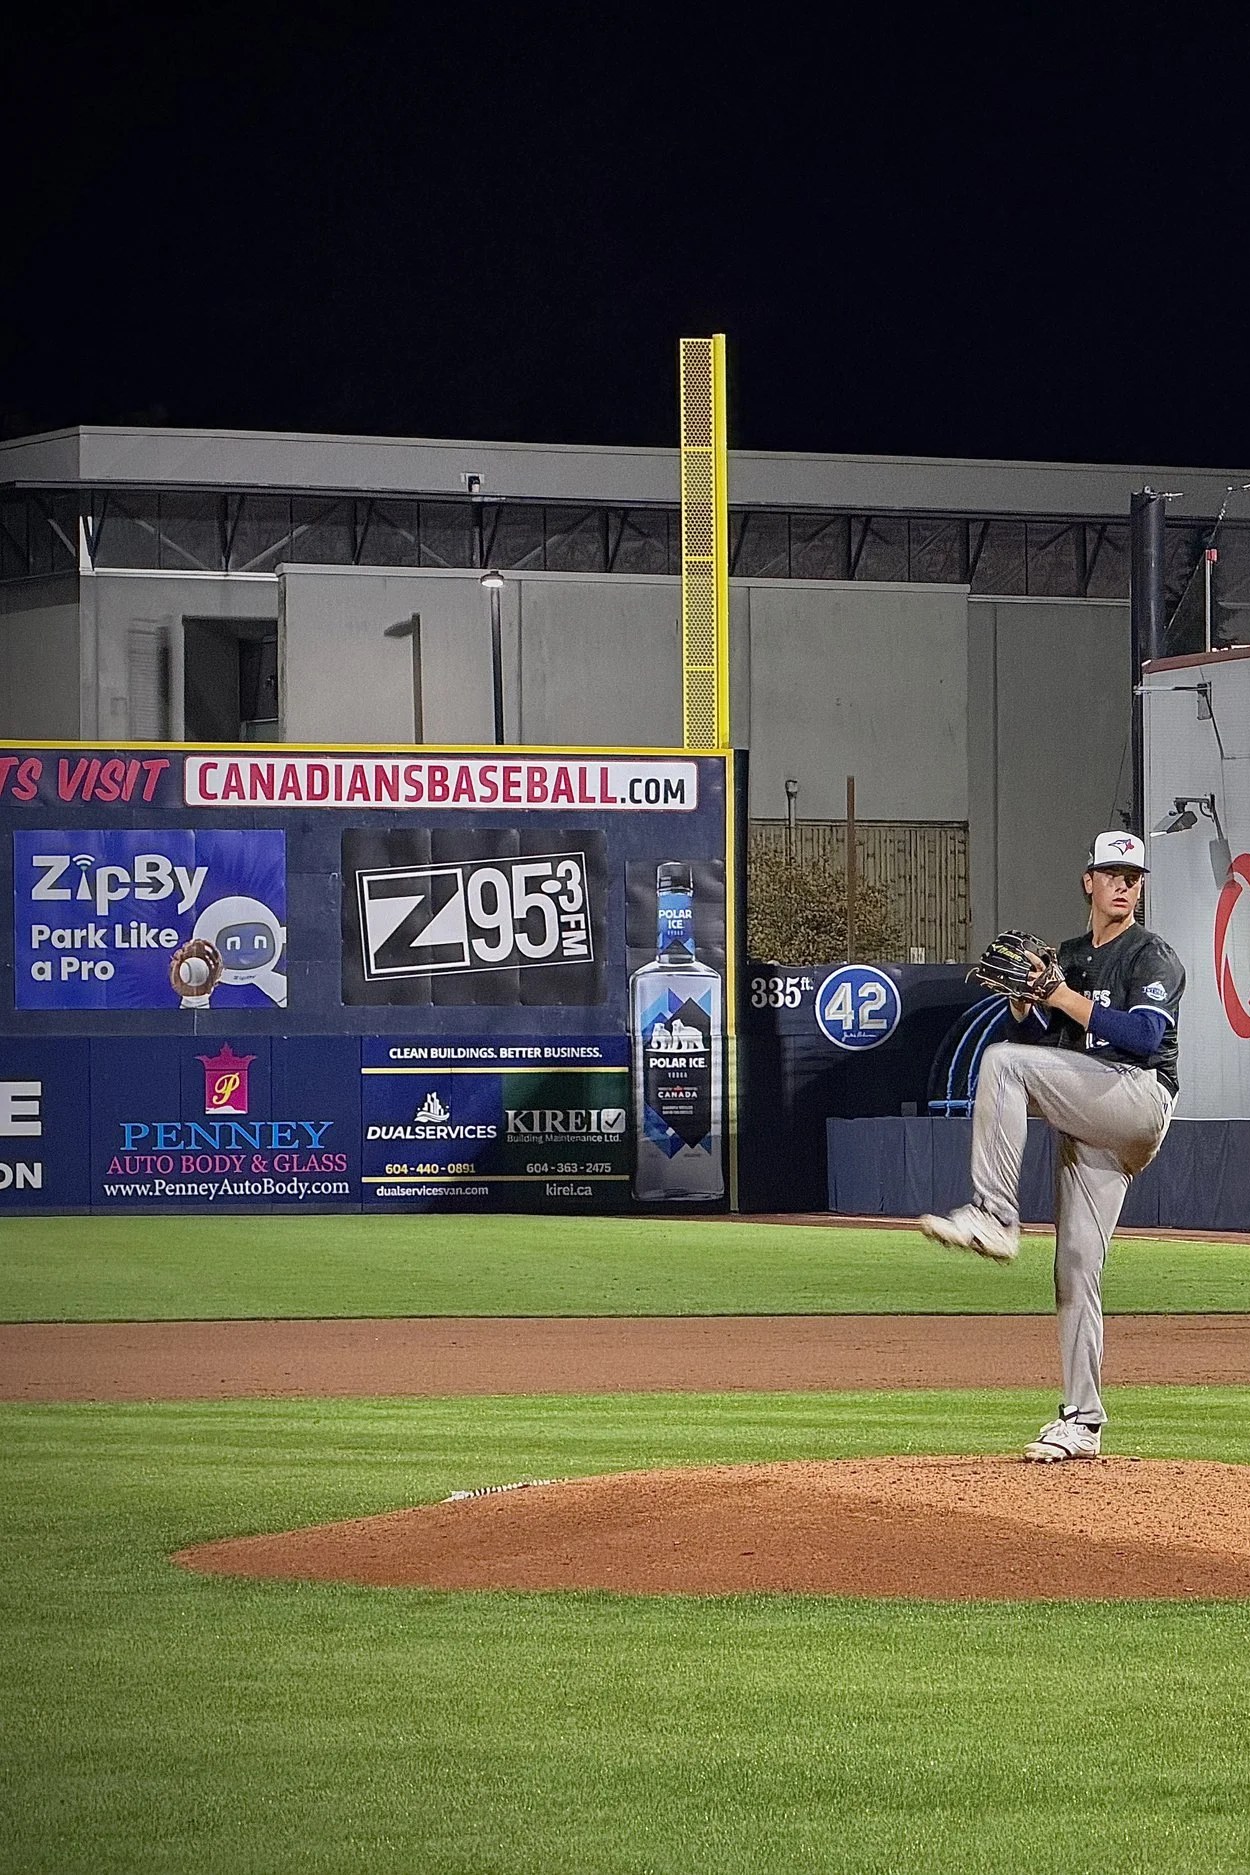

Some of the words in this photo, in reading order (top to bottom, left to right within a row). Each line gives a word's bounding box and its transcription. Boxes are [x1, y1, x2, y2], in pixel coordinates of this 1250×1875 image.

[58, 757, 171, 802] VISIT
[198, 762, 686, 804] CANADIANSBASEBALL.COM
[31, 854, 209, 916] ZipBy
[658, 909, 692, 919] POLAR
[668, 919, 684, 929] ICE
[31, 923, 108, 949] Park
[114, 921, 180, 949] Like
[31, 961, 52, 981] a
[61, 957, 115, 981] Pro
[825, 982, 888, 1030] 42
[389, 1048, 428, 1059] CLEAN
[430, 1048, 498, 1059] BUILDINGS.
[499, 1047, 542, 1059] BETTER
[543, 1047, 603, 1058] BUSINESS.
[649, 1057, 687, 1068] POLAR
[505, 1109, 601, 1133] KIREI
[119, 1121, 335, 1151] PENNEY
[366, 1125, 497, 1140] DUALSERVICES
[507, 1133, 544, 1144] Building
[545, 1133, 603, 1143] Maintenance
[604, 1133, 621, 1142] Ltd.
[106, 1155, 174, 1175] AUTO
[181, 1154, 247, 1175] BODY
[251, 1155, 267, 1174] &
[273, 1153, 348, 1173] GLASS
[104, 1178, 350, 1201] www.PenneyAutoBody.com
[376, 1185, 489, 1197] dualservicesvan.com
[545, 1183, 593, 1196] kirei.ca
